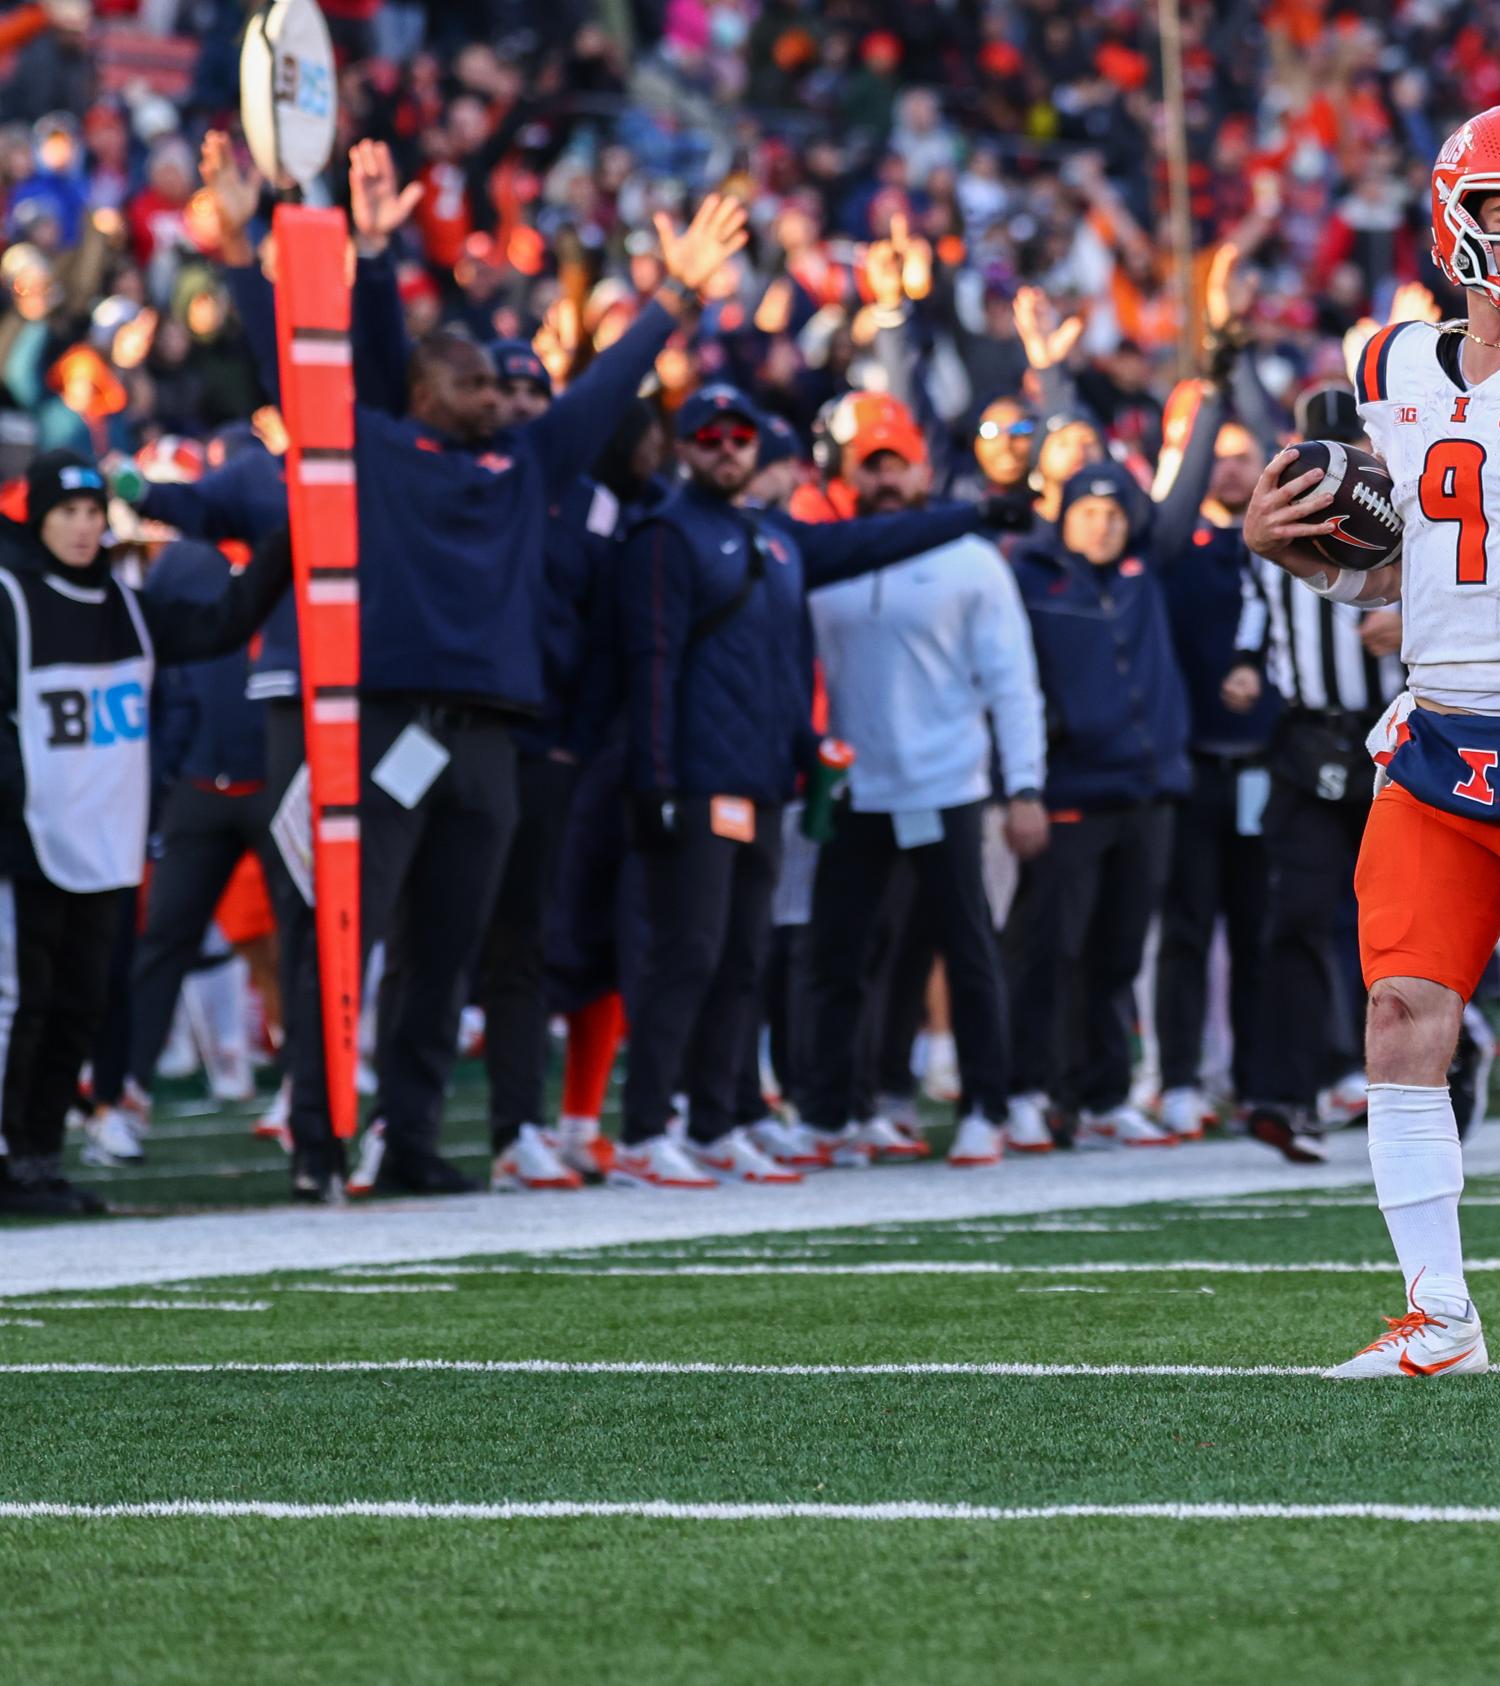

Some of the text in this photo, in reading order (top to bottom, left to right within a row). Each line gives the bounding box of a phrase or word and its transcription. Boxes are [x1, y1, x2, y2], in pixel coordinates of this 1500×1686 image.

[1450, 396, 1471, 423] I
[1418, 438, 1489, 585] 9
[1452, 748, 1498, 806] I
